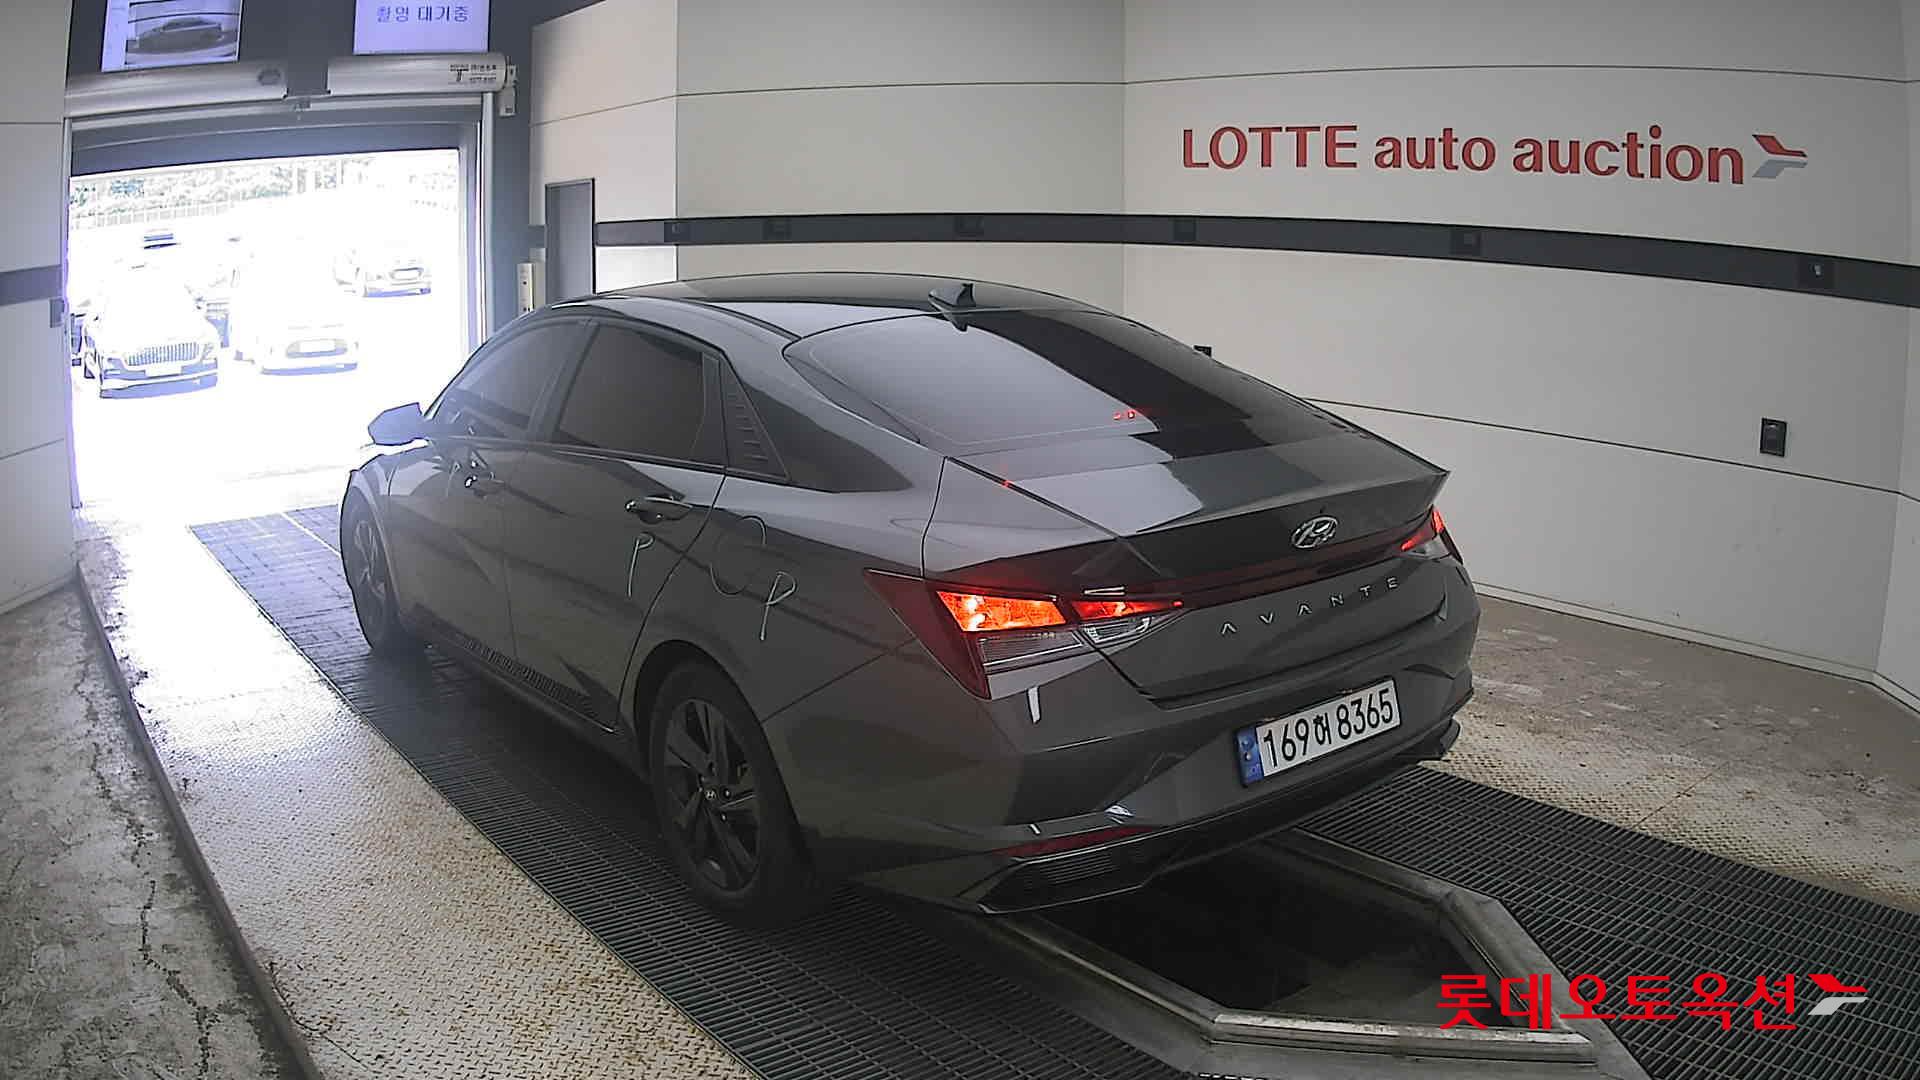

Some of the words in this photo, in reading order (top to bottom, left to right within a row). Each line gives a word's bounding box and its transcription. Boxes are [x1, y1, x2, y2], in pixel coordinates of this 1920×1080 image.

[418, 5, 469, 23] 대기중
[1182, 124, 1358, 170] LOTTE
[1374, 127, 1496, 171] auto
[1512, 124, 1745, 185] auction
[1220, 576, 1399, 635] AVANTE
[1262, 712, 1333, 769] 169허
[1335, 687, 1395, 741] 8365
